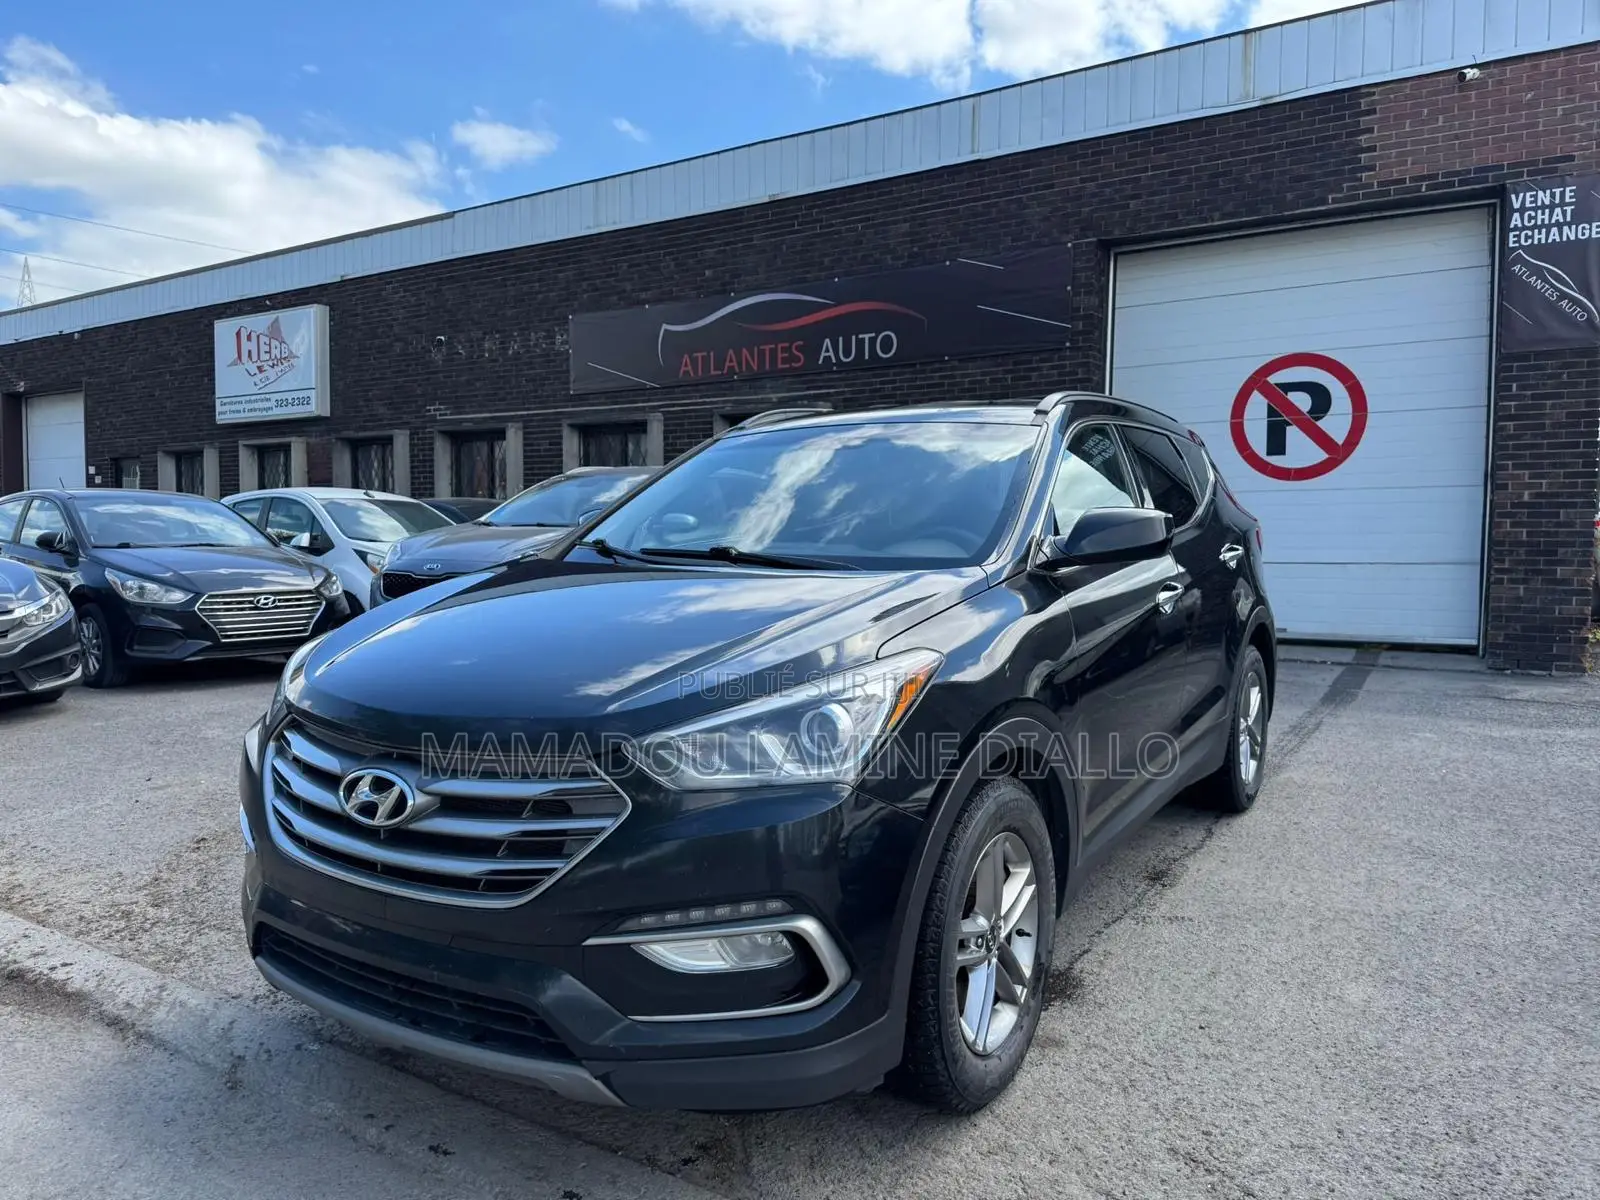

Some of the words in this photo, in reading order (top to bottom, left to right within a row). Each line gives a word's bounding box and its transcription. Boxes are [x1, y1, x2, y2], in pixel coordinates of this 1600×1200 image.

[1511, 186, 1577, 209] VENTE
[1509, 206, 1575, 228] ACHAT
[1508, 222, 1600, 248] ECHANGE
[1511, 263, 1560, 301] ATLANTES
[1558, 298, 1588, 322] AUTO
[235, 325, 290, 365] HERB
[679, 340, 805, 378] ATLANTES
[818, 331, 898, 365] AUTO
[274, 396, 312, 408] 323-2322
